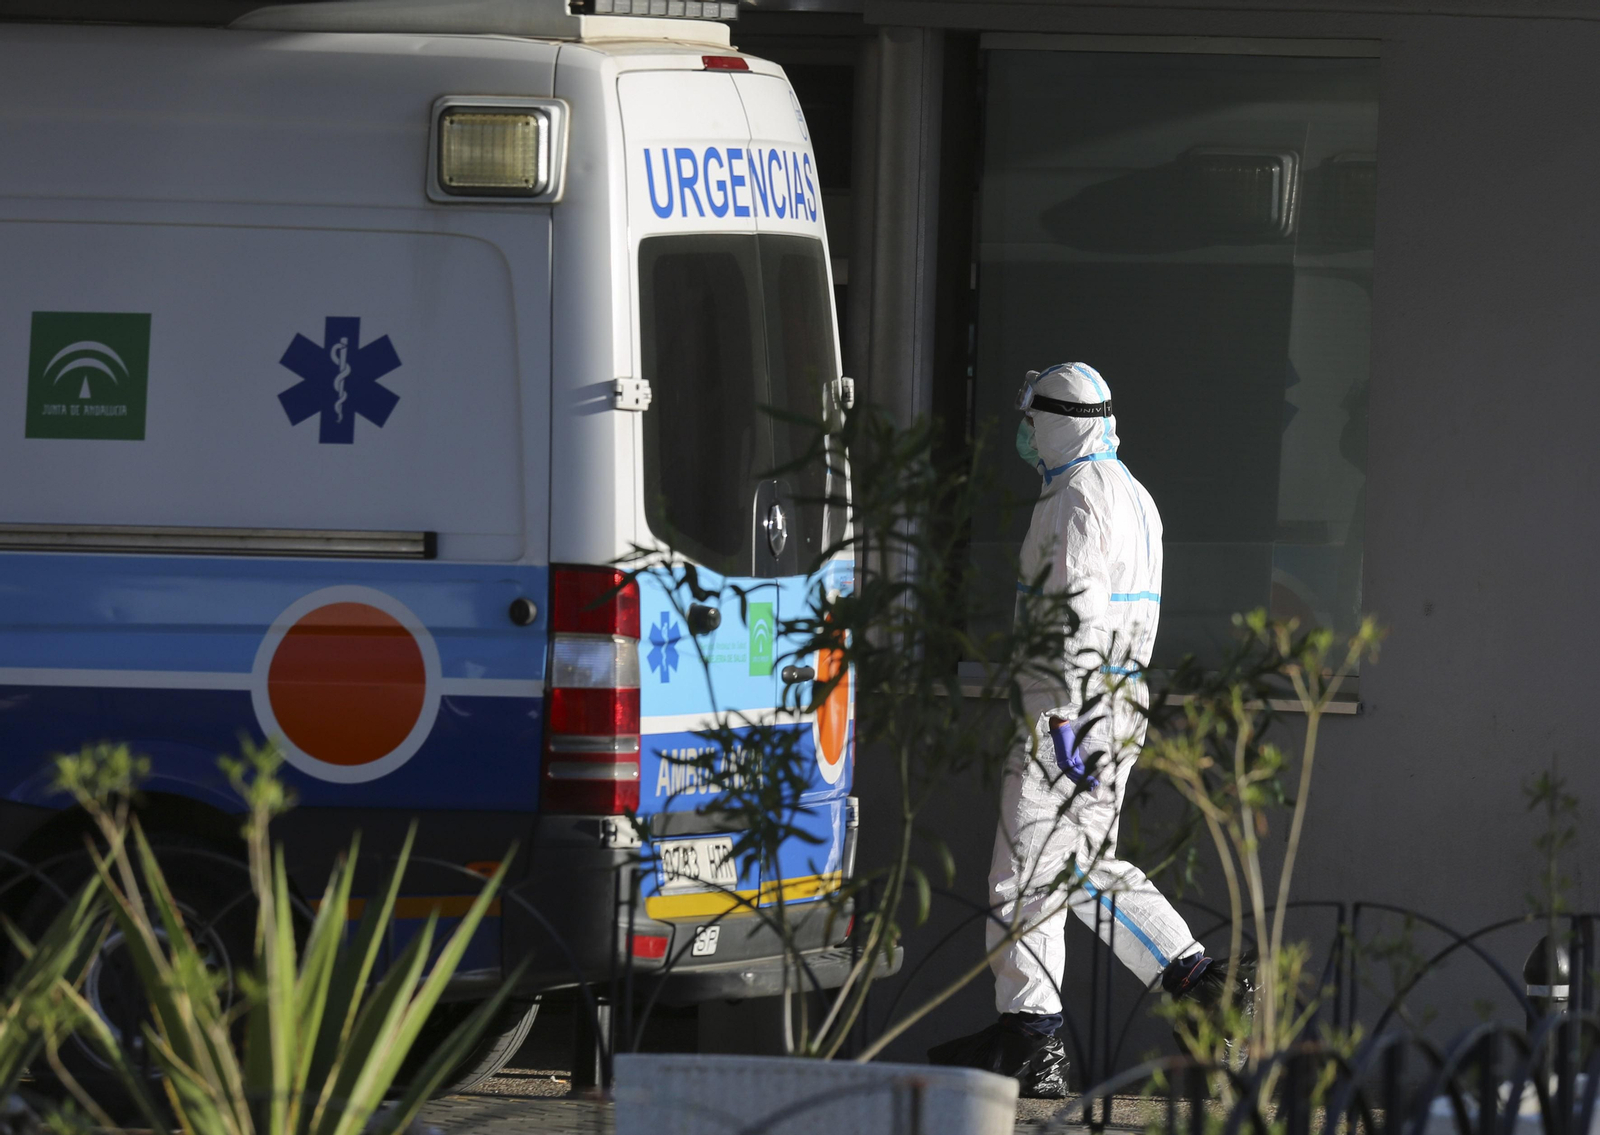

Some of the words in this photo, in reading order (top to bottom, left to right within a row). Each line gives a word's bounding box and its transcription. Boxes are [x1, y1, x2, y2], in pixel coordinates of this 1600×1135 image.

[643, 146, 816, 222] URGENCIAS
[42, 404, 67, 415] JUNTA
[70, 404, 80, 416] DE
[697, 928, 717, 951] SP
